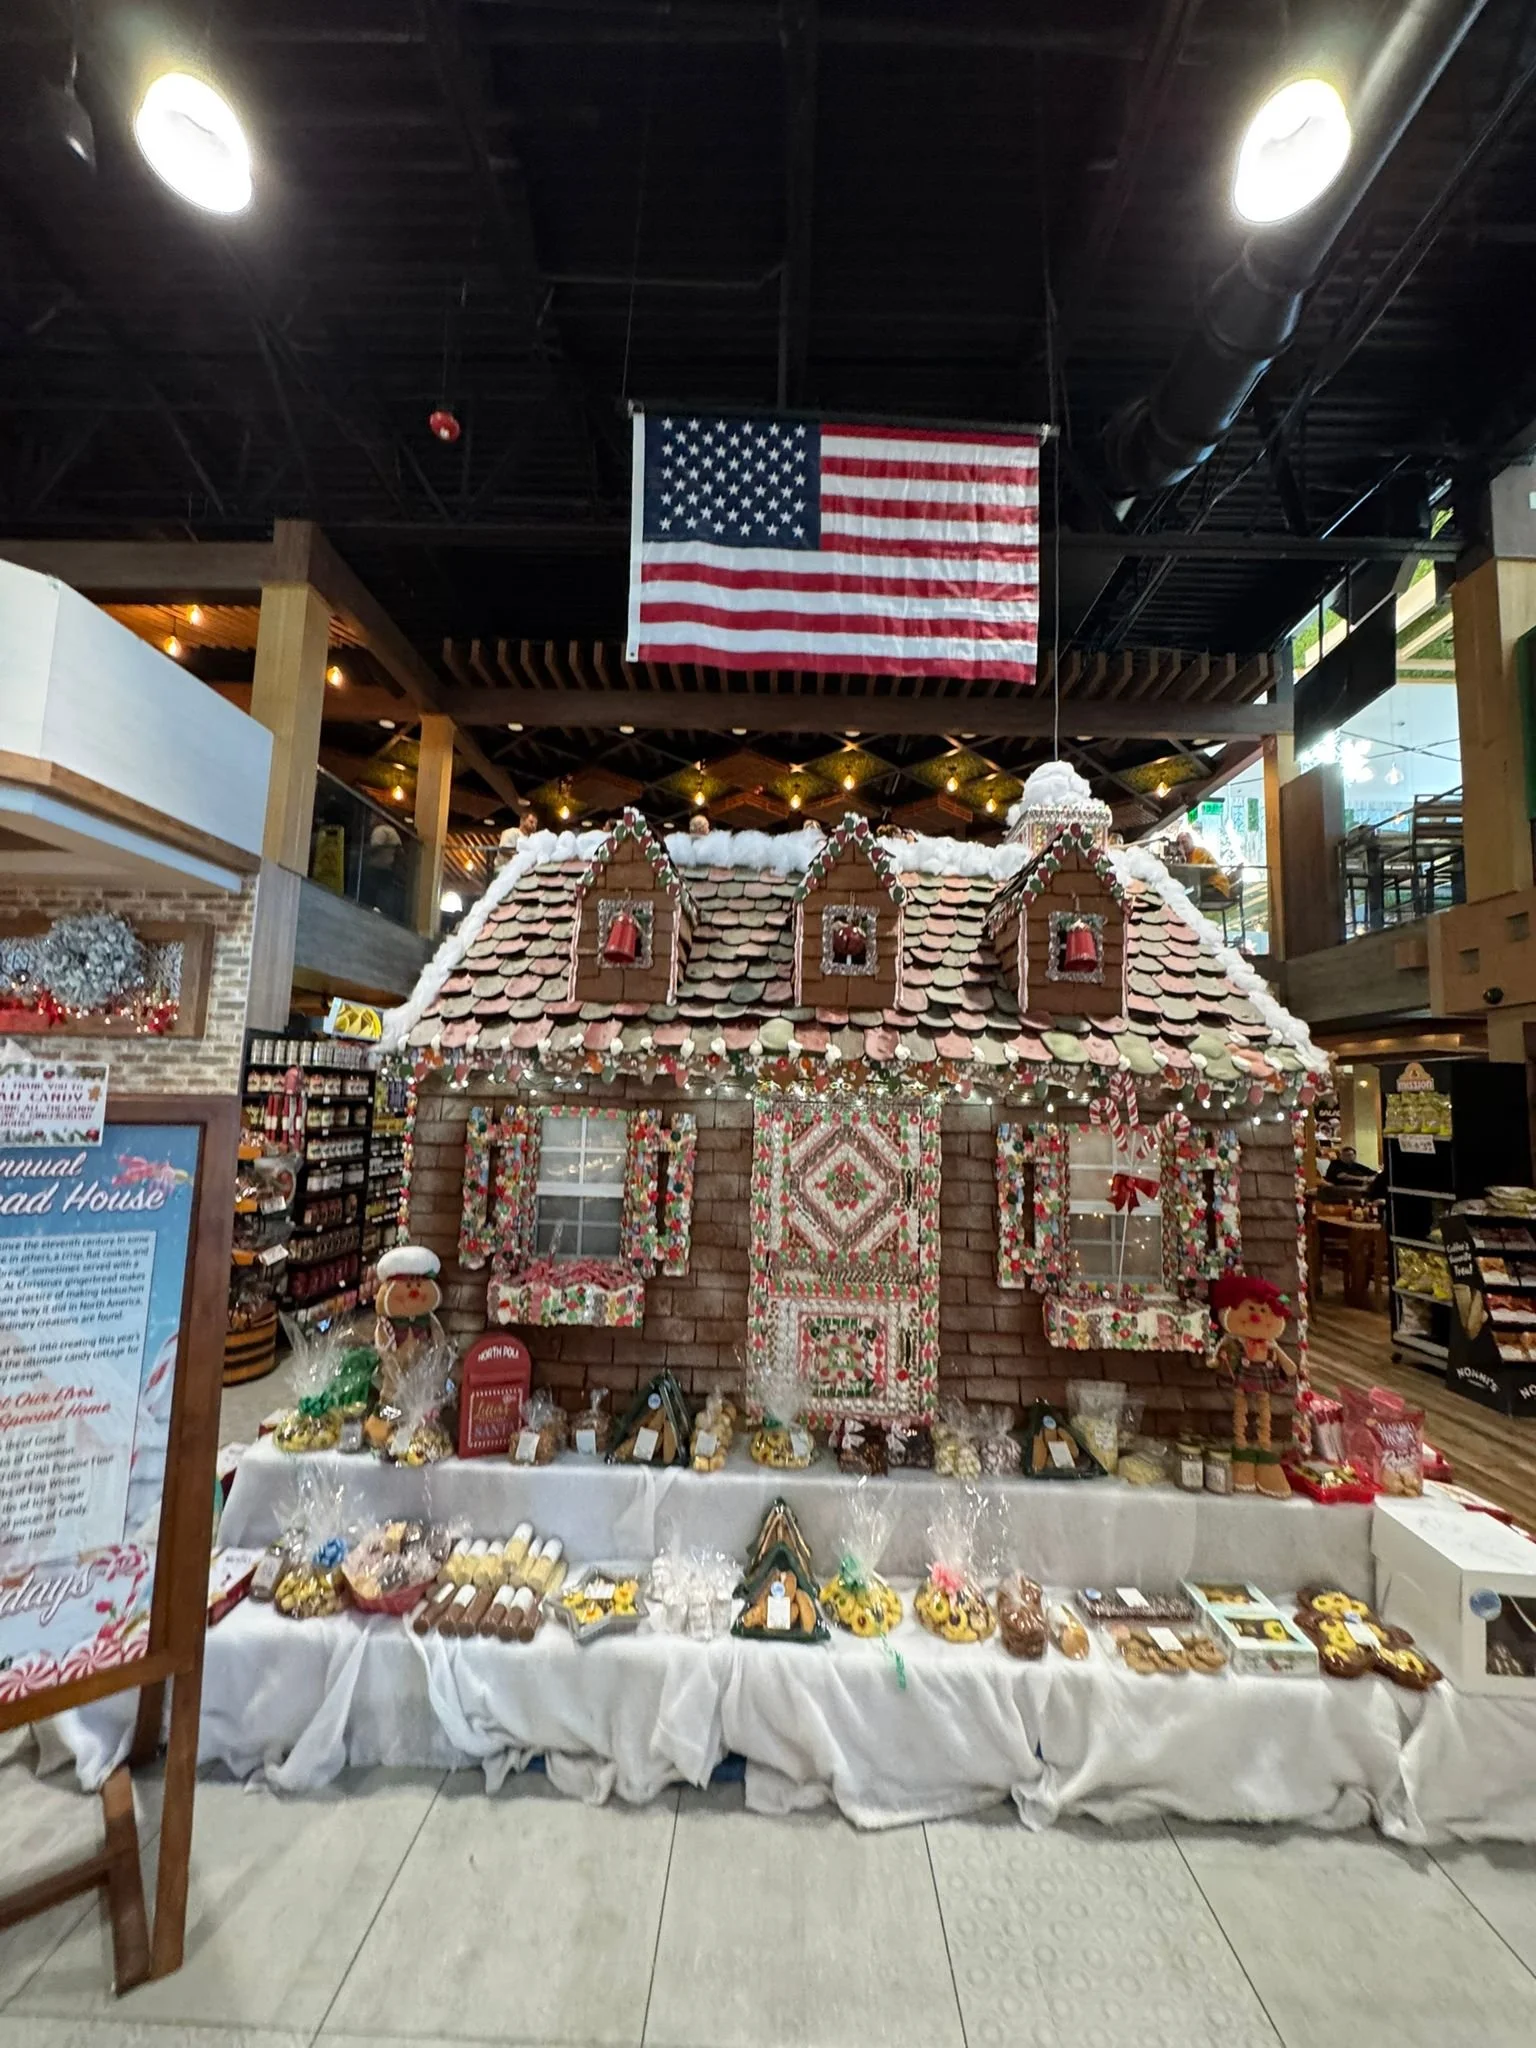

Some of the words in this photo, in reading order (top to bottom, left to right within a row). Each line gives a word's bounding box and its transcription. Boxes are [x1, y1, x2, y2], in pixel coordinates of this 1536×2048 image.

[30, 1093, 83, 1102] CANDY
[61, 1179, 166, 1214] House
[1456, 1365, 1500, 1395] NONNI'S
[0, 1560, 96, 1628] days
